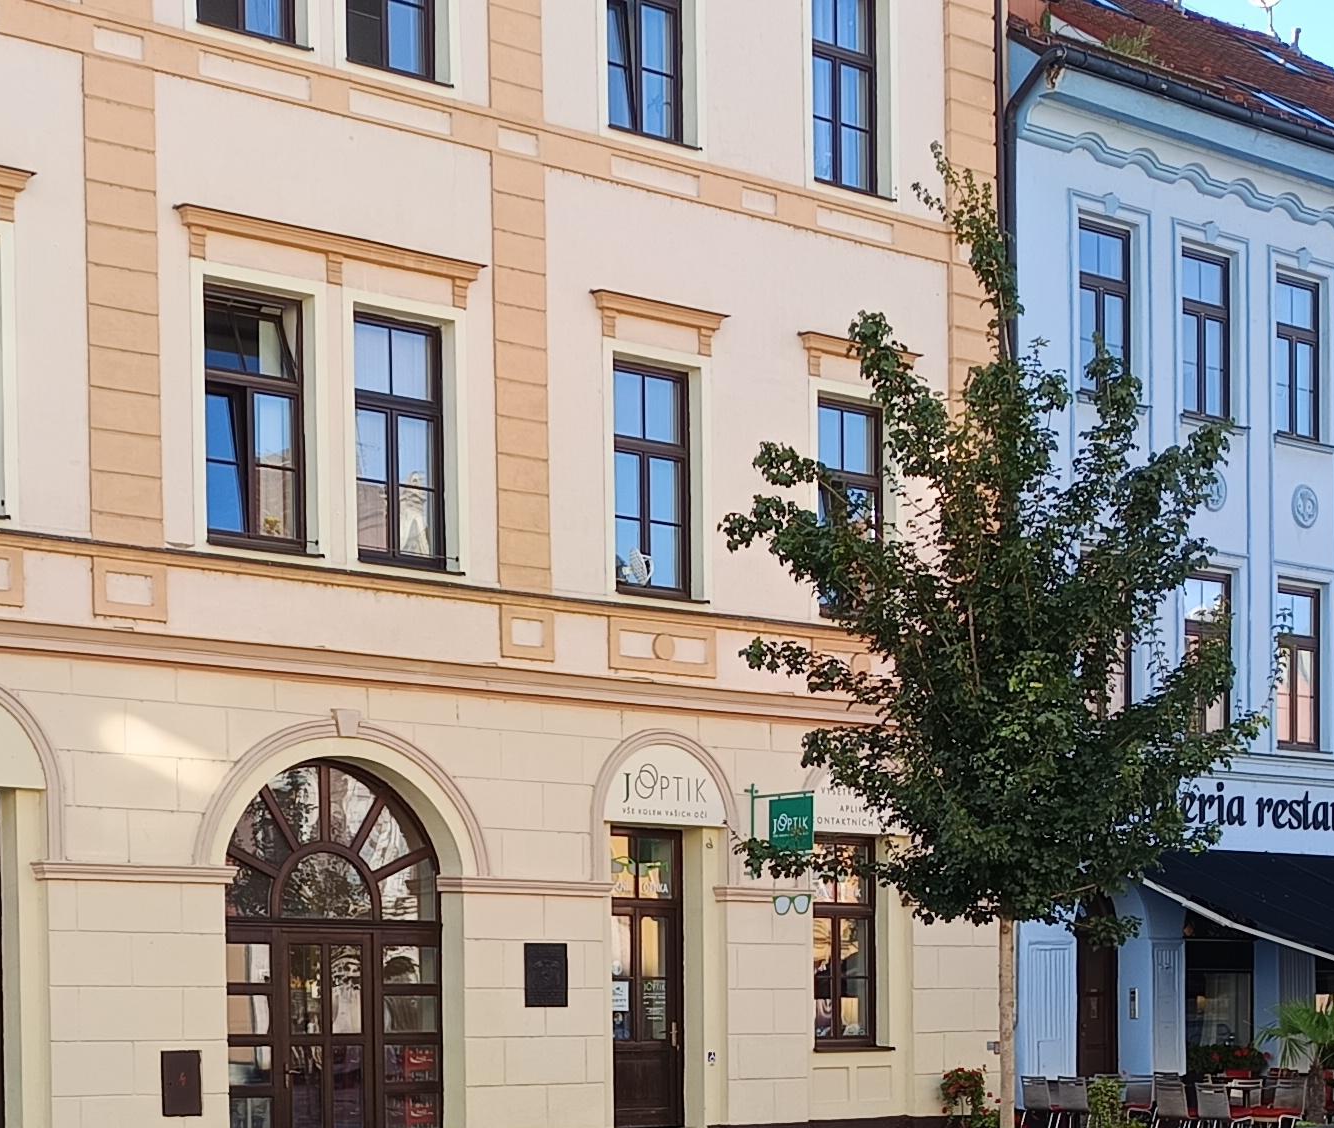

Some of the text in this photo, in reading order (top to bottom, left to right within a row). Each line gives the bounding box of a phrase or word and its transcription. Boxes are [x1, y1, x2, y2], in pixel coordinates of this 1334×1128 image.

[622, 806, 635, 815] VŠE
[638, 808, 662, 816] KOLEM
[664, 809, 691, 818] VAŠICH
[817, 815, 874, 827] ONTAKTNÍCH
